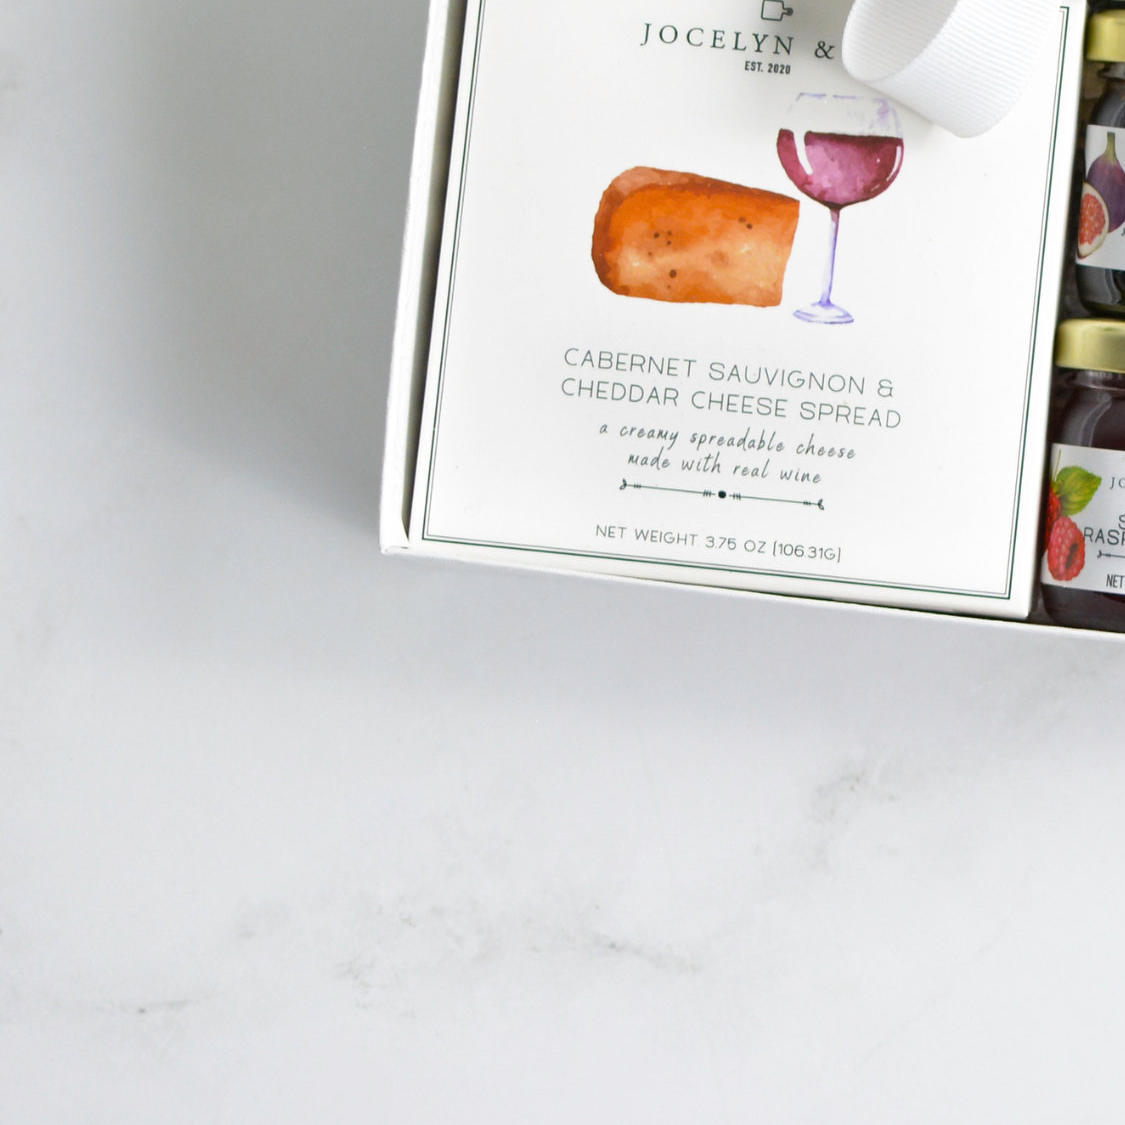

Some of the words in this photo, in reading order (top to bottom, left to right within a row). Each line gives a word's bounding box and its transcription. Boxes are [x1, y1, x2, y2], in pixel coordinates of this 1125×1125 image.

[640, 22, 795, 57] JOCELYN
[814, 40, 835, 60] &
[744, 60, 764, 74] EST.
[767, 62, 792, 75] 2020
[563, 347, 697, 378] CABERNET
[708, 361, 866, 395] SAUVIGNON
[877, 379, 894, 398] &
[561, 377, 680, 407] CHEDDAR
[691, 391, 787, 418] CHEESE
[799, 400, 901, 428] SPREAD
[599, 423, 608, 434] a
[619, 424, 679, 450] creamy
[689, 427, 785, 453] spreadable
[796, 433, 856, 460] cheese
[628, 446, 671, 468] made
[682, 454, 721, 474] with
[733, 459, 769, 479] real
[780, 467, 822, 484] wine
[595, 524, 627, 540] NET
[705, 535, 737, 551] 3.75
[744, 540, 767, 554] OZ
[1106, 574, 1125, 588] NET
